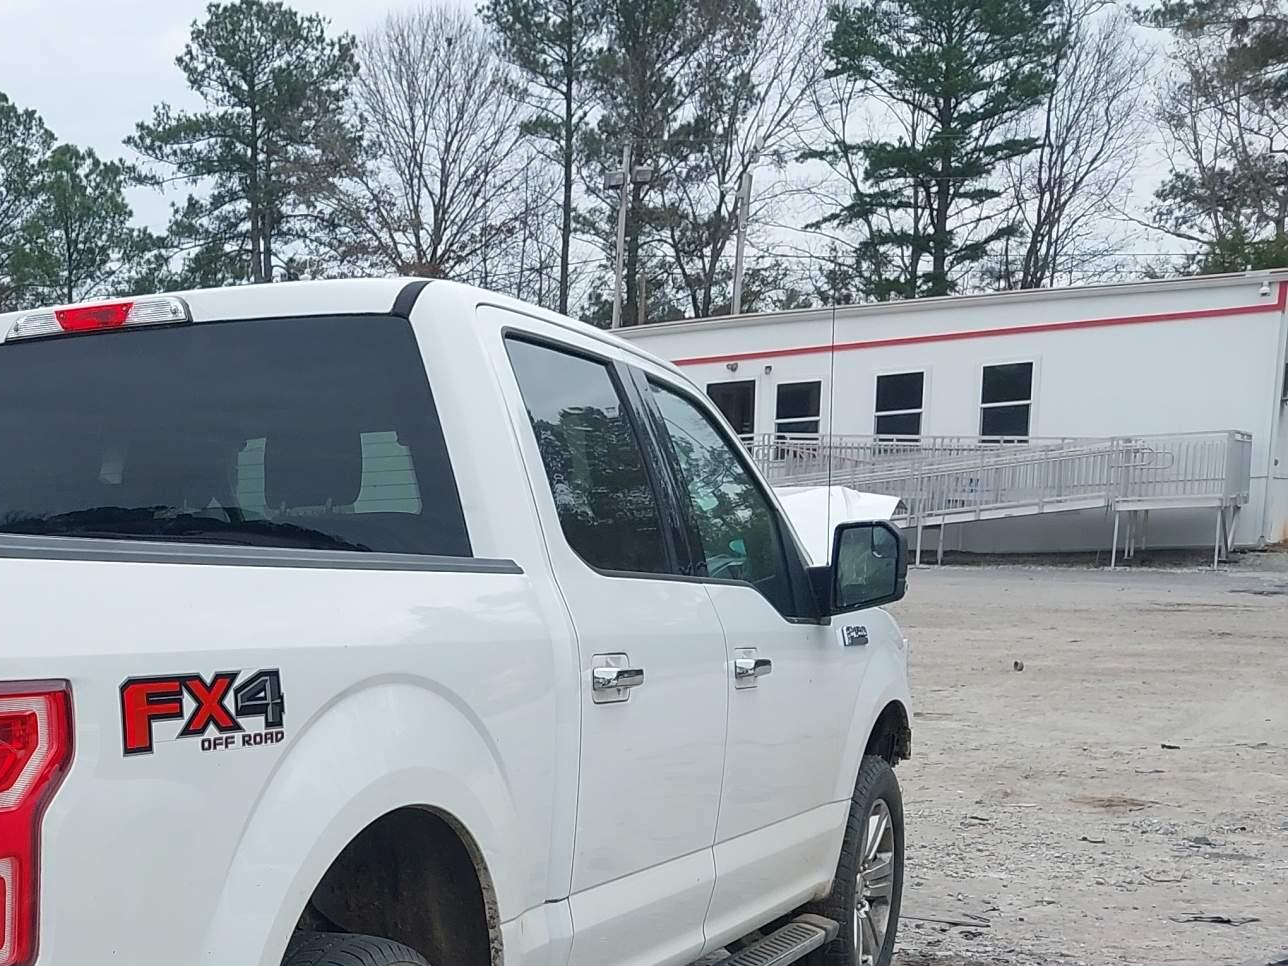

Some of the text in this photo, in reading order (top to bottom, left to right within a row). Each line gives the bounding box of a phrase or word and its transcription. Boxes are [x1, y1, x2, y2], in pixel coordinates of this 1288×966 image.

[118, 668, 285, 757] FX4
[201, 731, 285, 752] OFF ROAD
